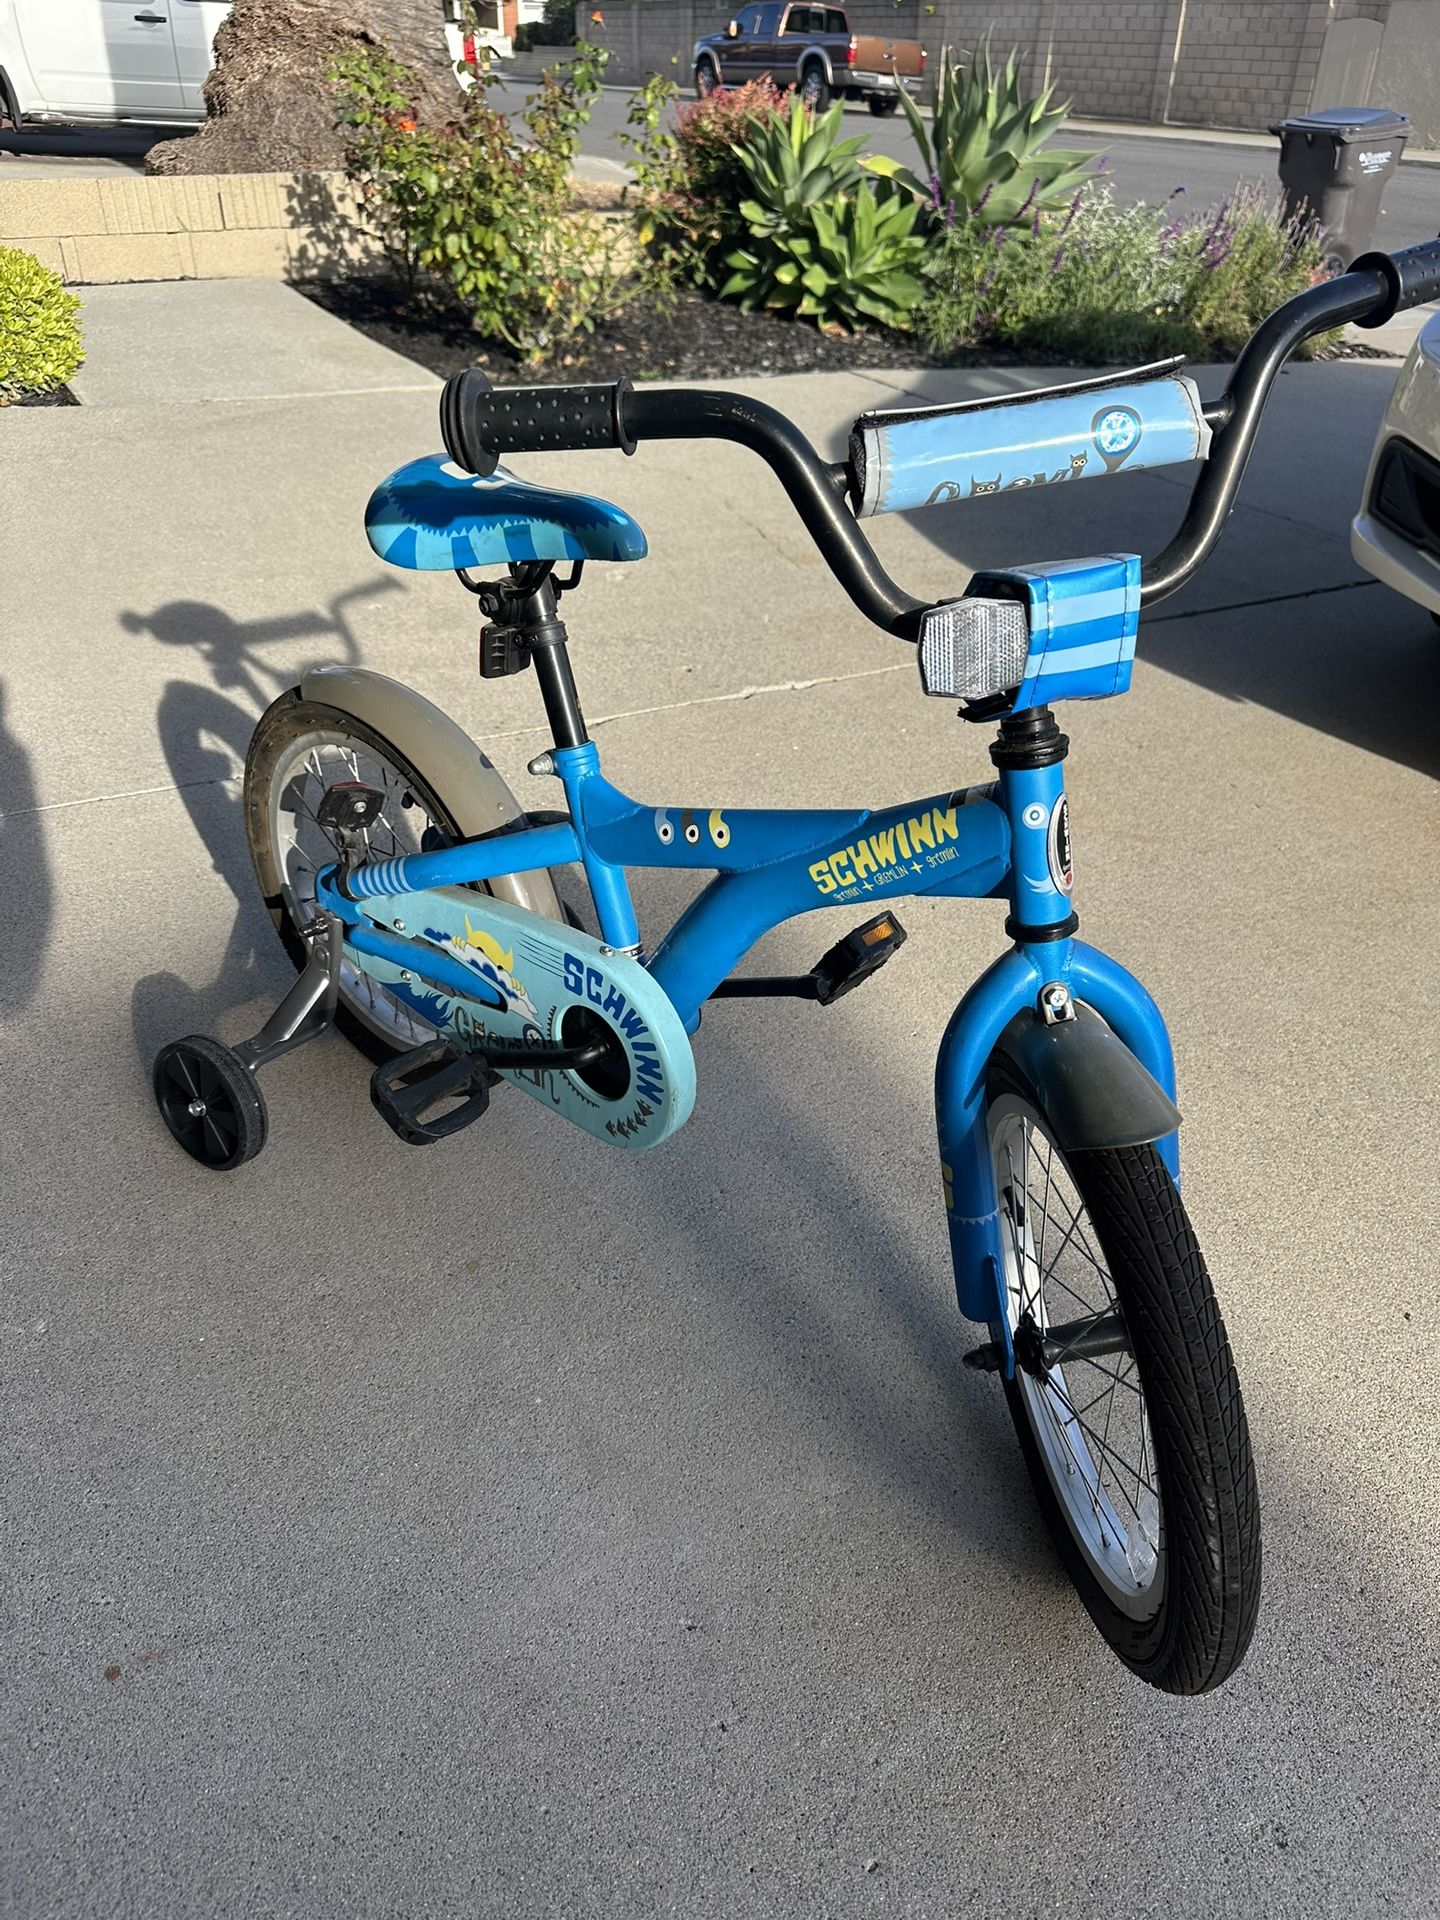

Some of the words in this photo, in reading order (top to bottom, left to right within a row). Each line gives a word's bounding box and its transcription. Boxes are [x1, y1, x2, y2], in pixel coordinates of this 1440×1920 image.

[808, 807, 959, 894] SCHWINN
[873, 866, 909, 886] GREMLIN
[563, 952, 665, 1106] SCHWINN
